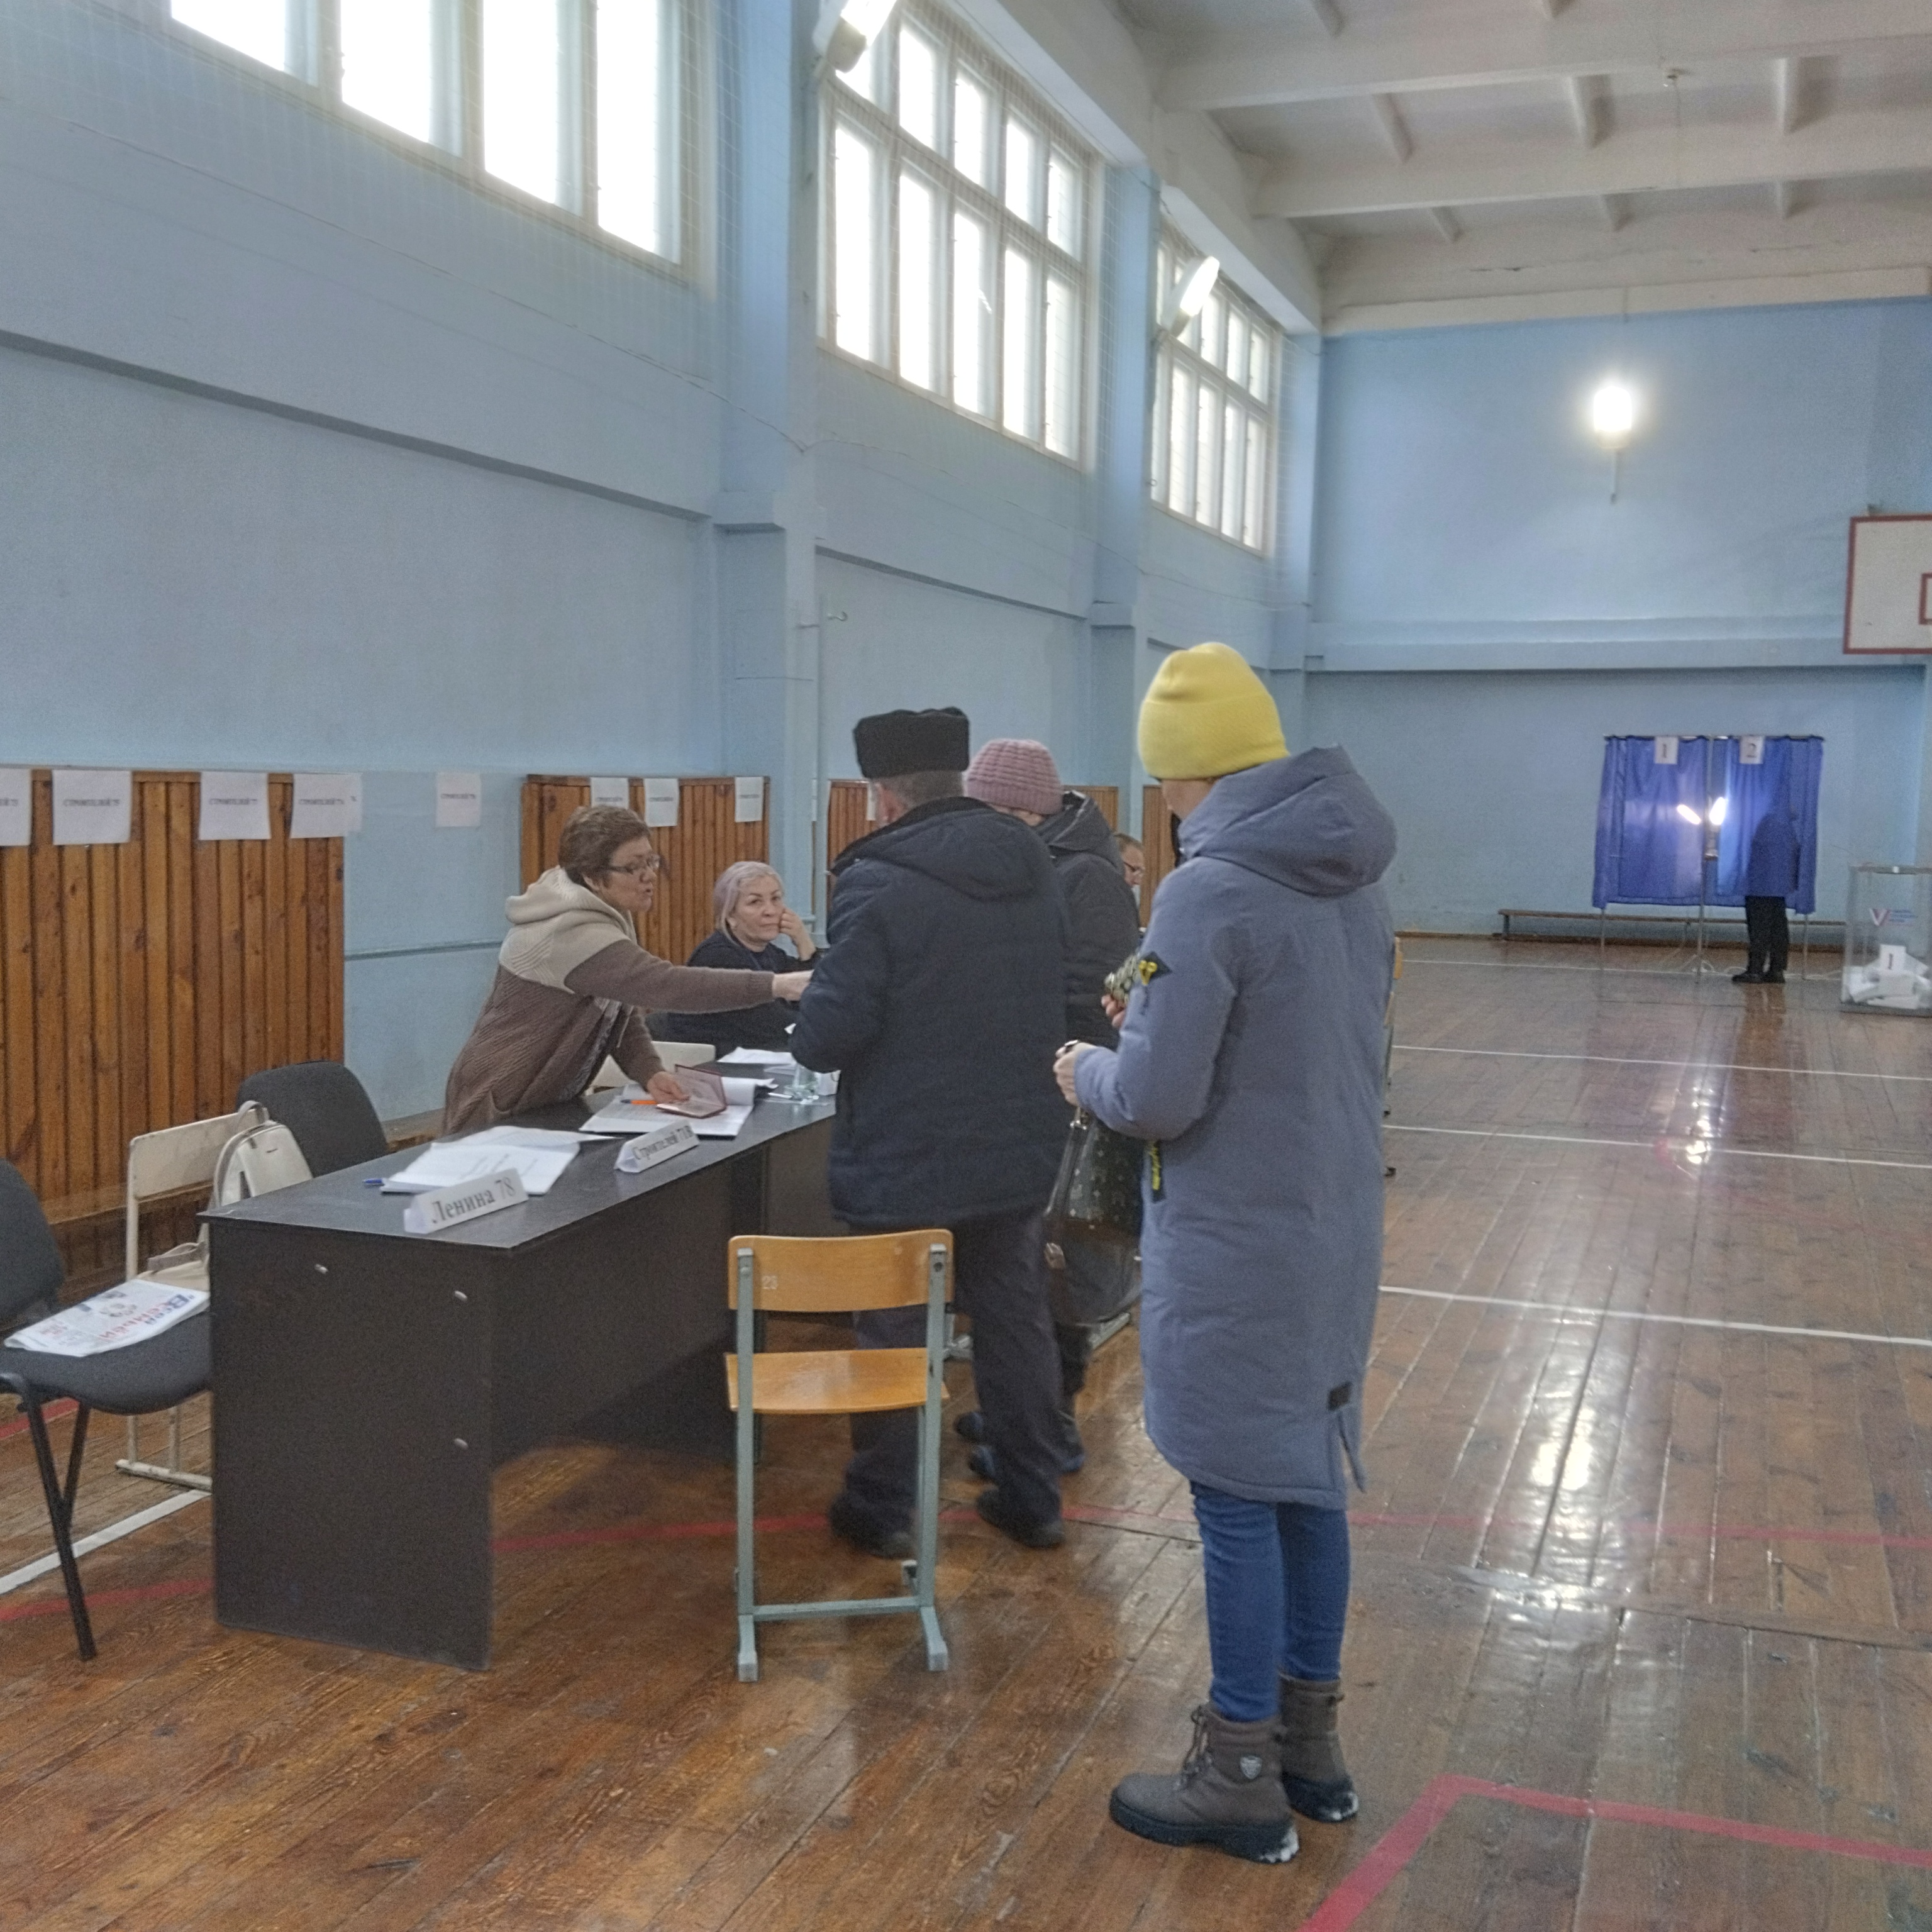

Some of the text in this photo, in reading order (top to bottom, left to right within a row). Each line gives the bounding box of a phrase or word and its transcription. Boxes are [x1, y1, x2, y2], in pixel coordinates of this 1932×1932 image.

[1746, 742, 1757, 758] 2
[431, 1176, 516, 1224] Ленина 78
